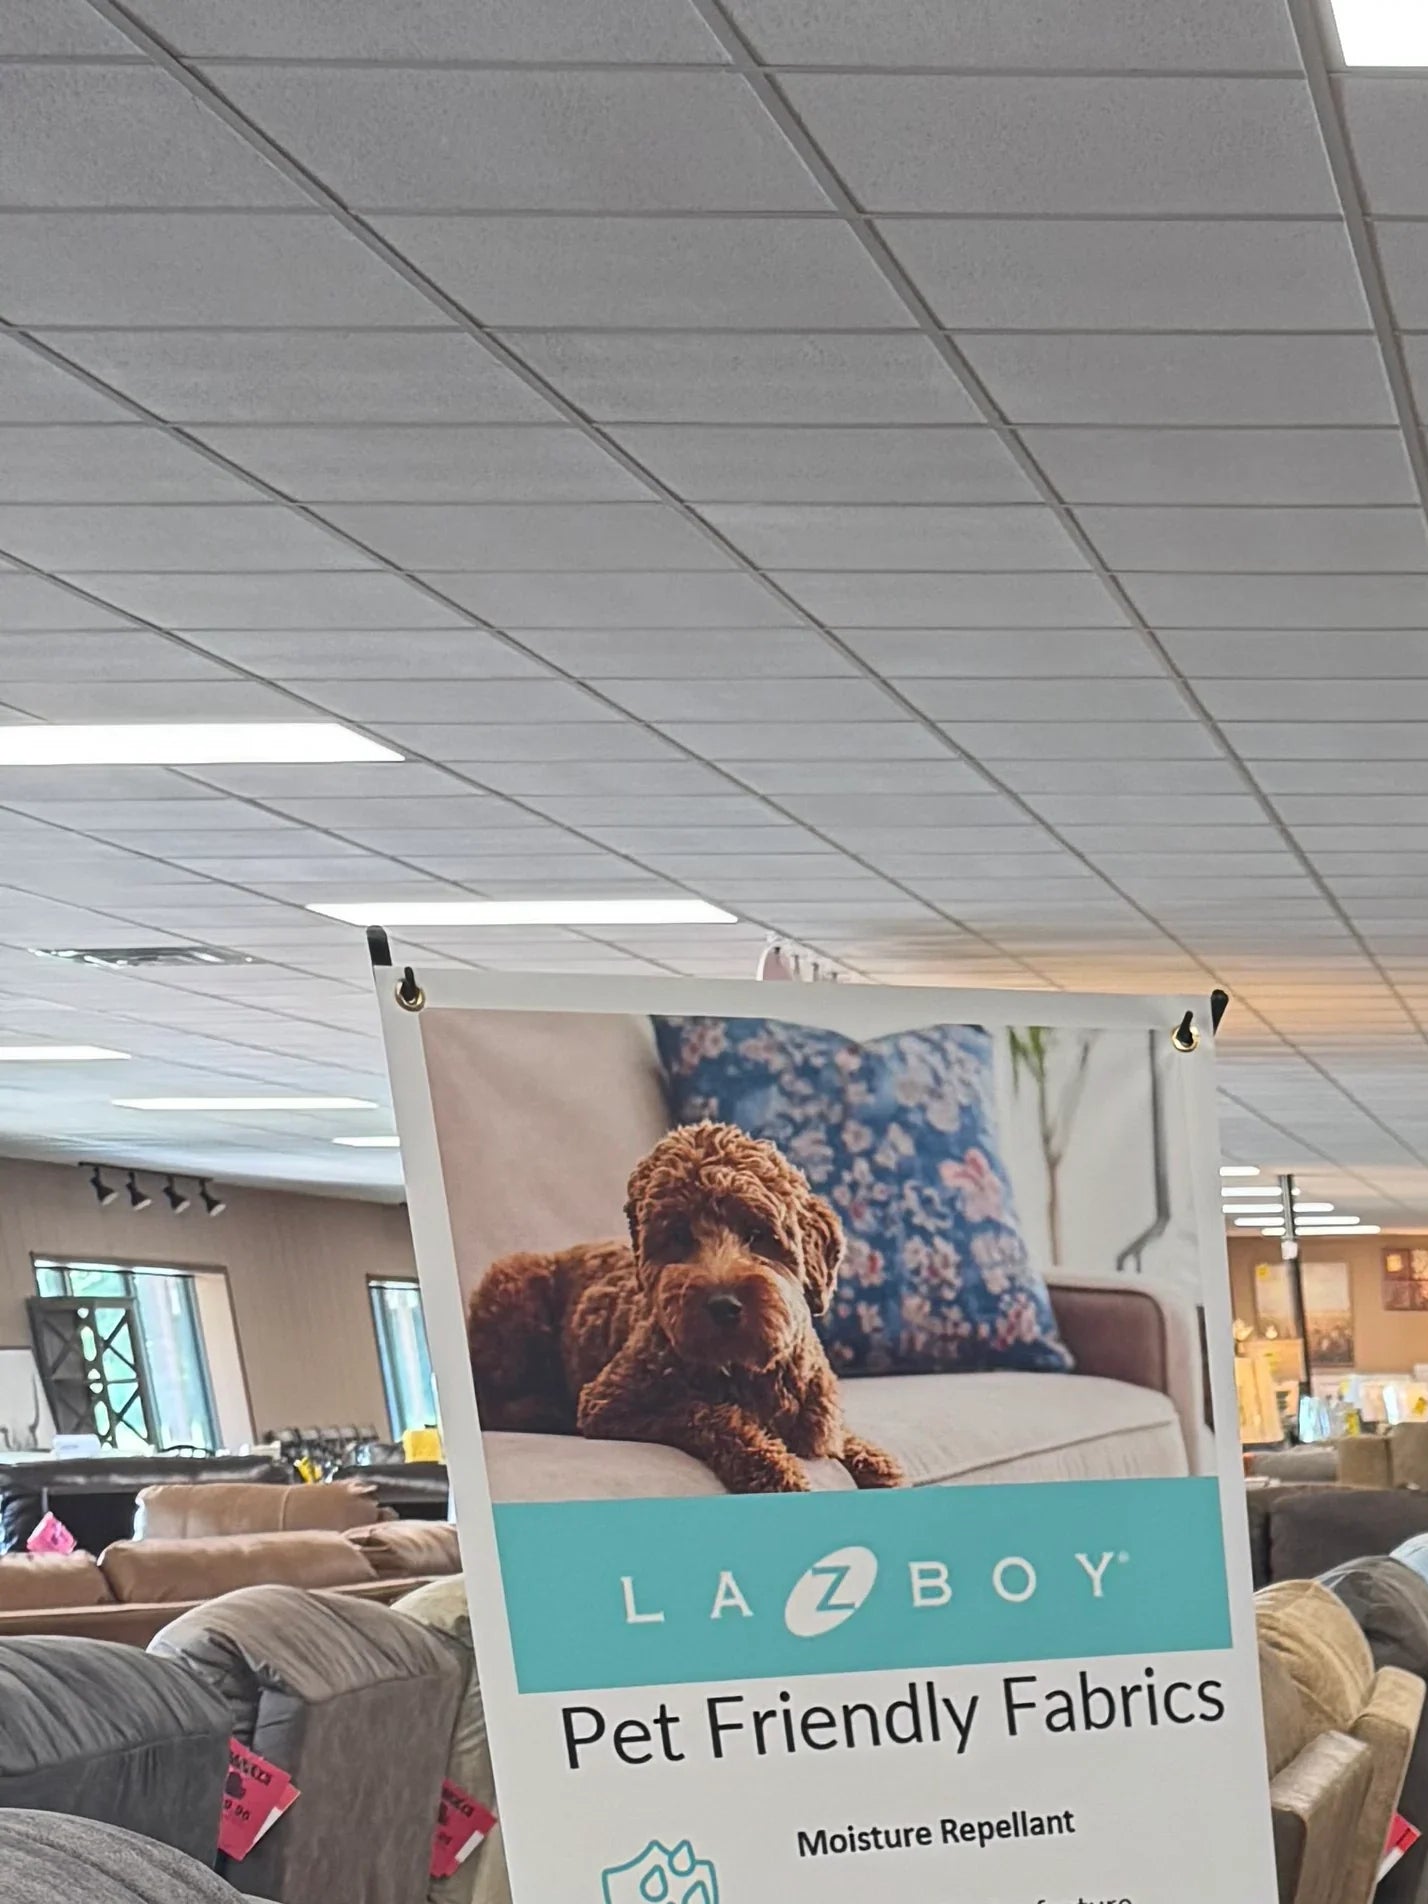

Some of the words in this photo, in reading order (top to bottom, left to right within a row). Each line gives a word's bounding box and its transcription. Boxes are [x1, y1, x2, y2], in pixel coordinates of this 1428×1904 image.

[562, 1704, 685, 1769] Pet
[707, 1681, 978, 1758] Friendly
[1003, 1667, 1224, 1736] Fabrics
[798, 1825, 932, 1857] Moisture
[941, 1811, 1075, 1848] Repellant
